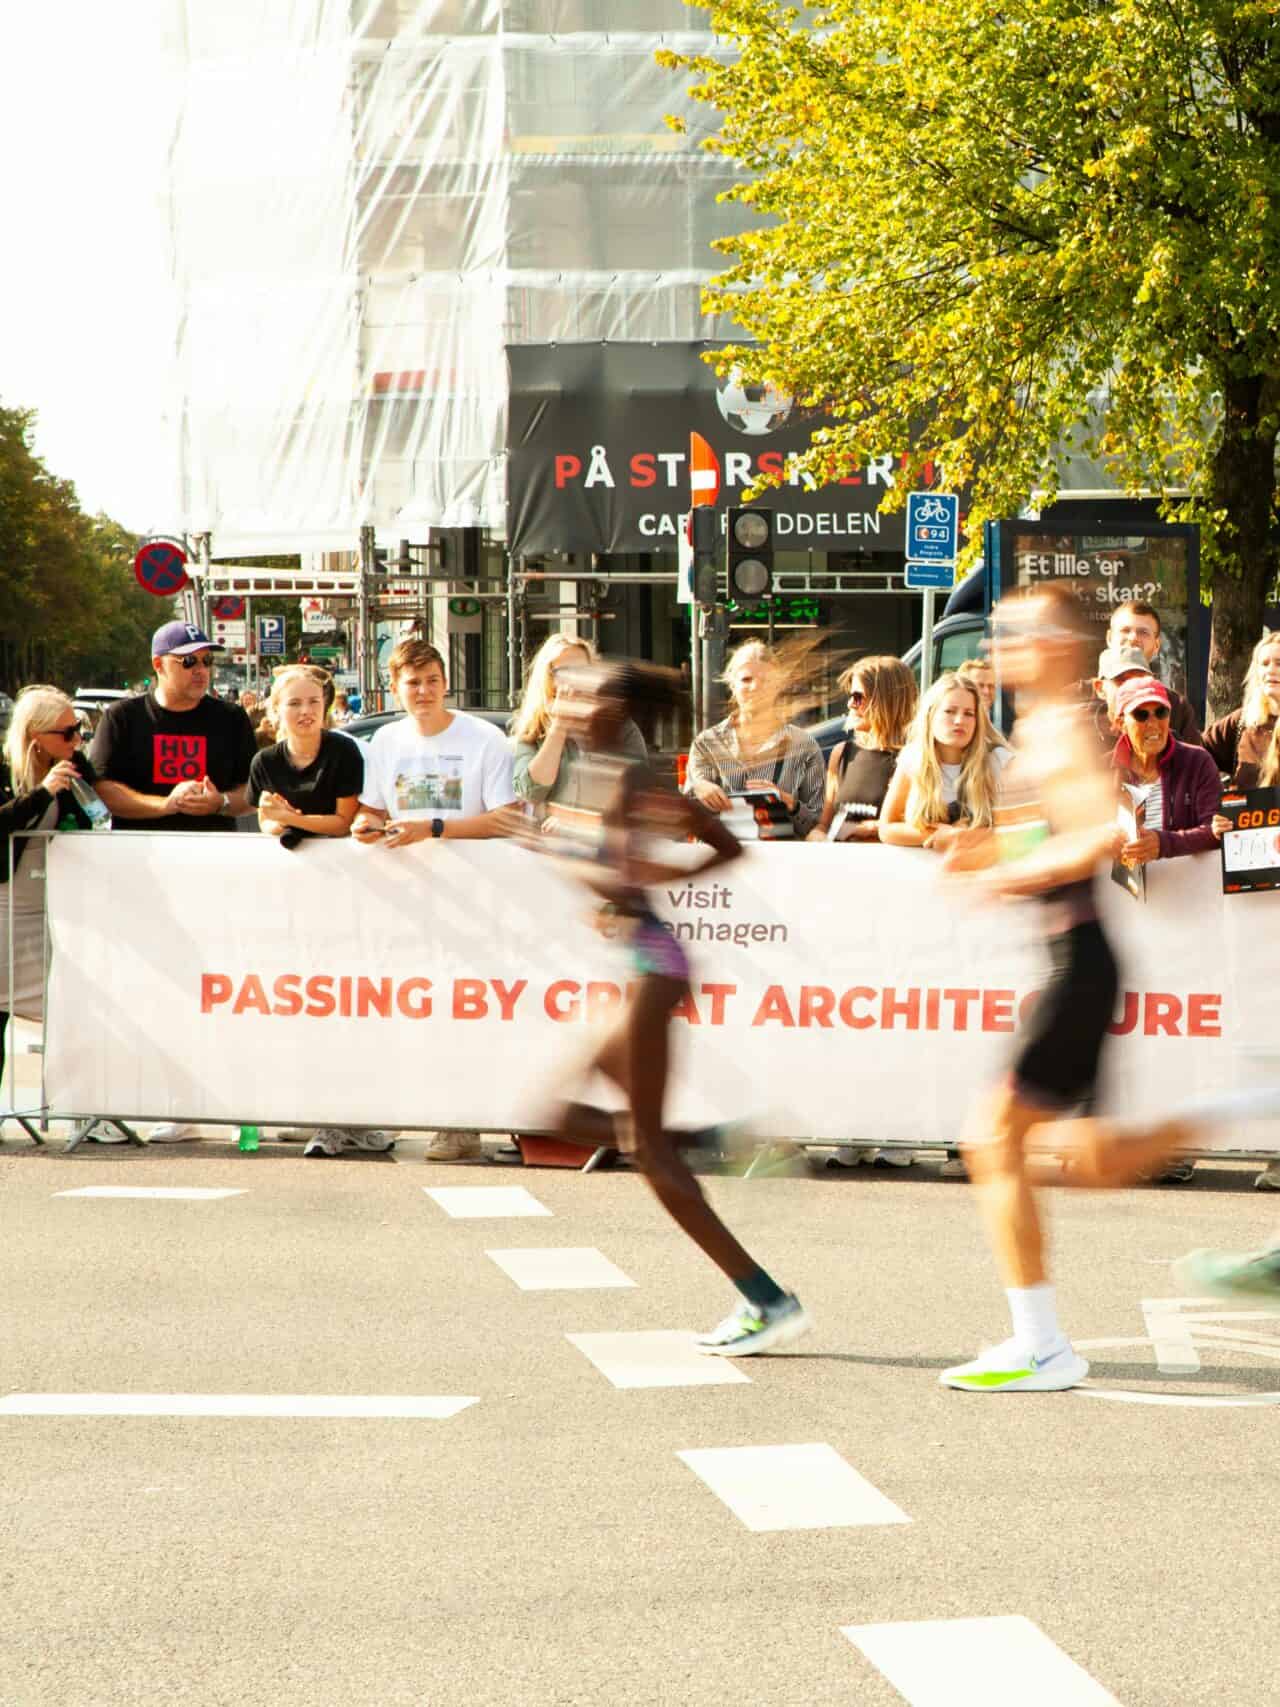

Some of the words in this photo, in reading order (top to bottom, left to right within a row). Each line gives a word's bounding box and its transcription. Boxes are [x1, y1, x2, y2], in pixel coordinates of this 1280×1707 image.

[555, 445, 616, 488] PÅ
[930, 530, 946, 539] 94
[1025, 555, 1049, 575] Et
[1054, 554, 1090, 575] lille
[263, 618, 279, 638] P
[161, 739, 199, 758] HU
[160, 759, 200, 778] GO
[1238, 811, 1264, 828] GO
[668, 883, 733, 909] visit
[602, 917, 788, 948] enhagen
[200, 973, 432, 1019] PASSING
[453, 978, 528, 1021] BY
[543, 980, 737, 1025] GRAT
[752, 984, 1222, 1037] ARCHITEURE
